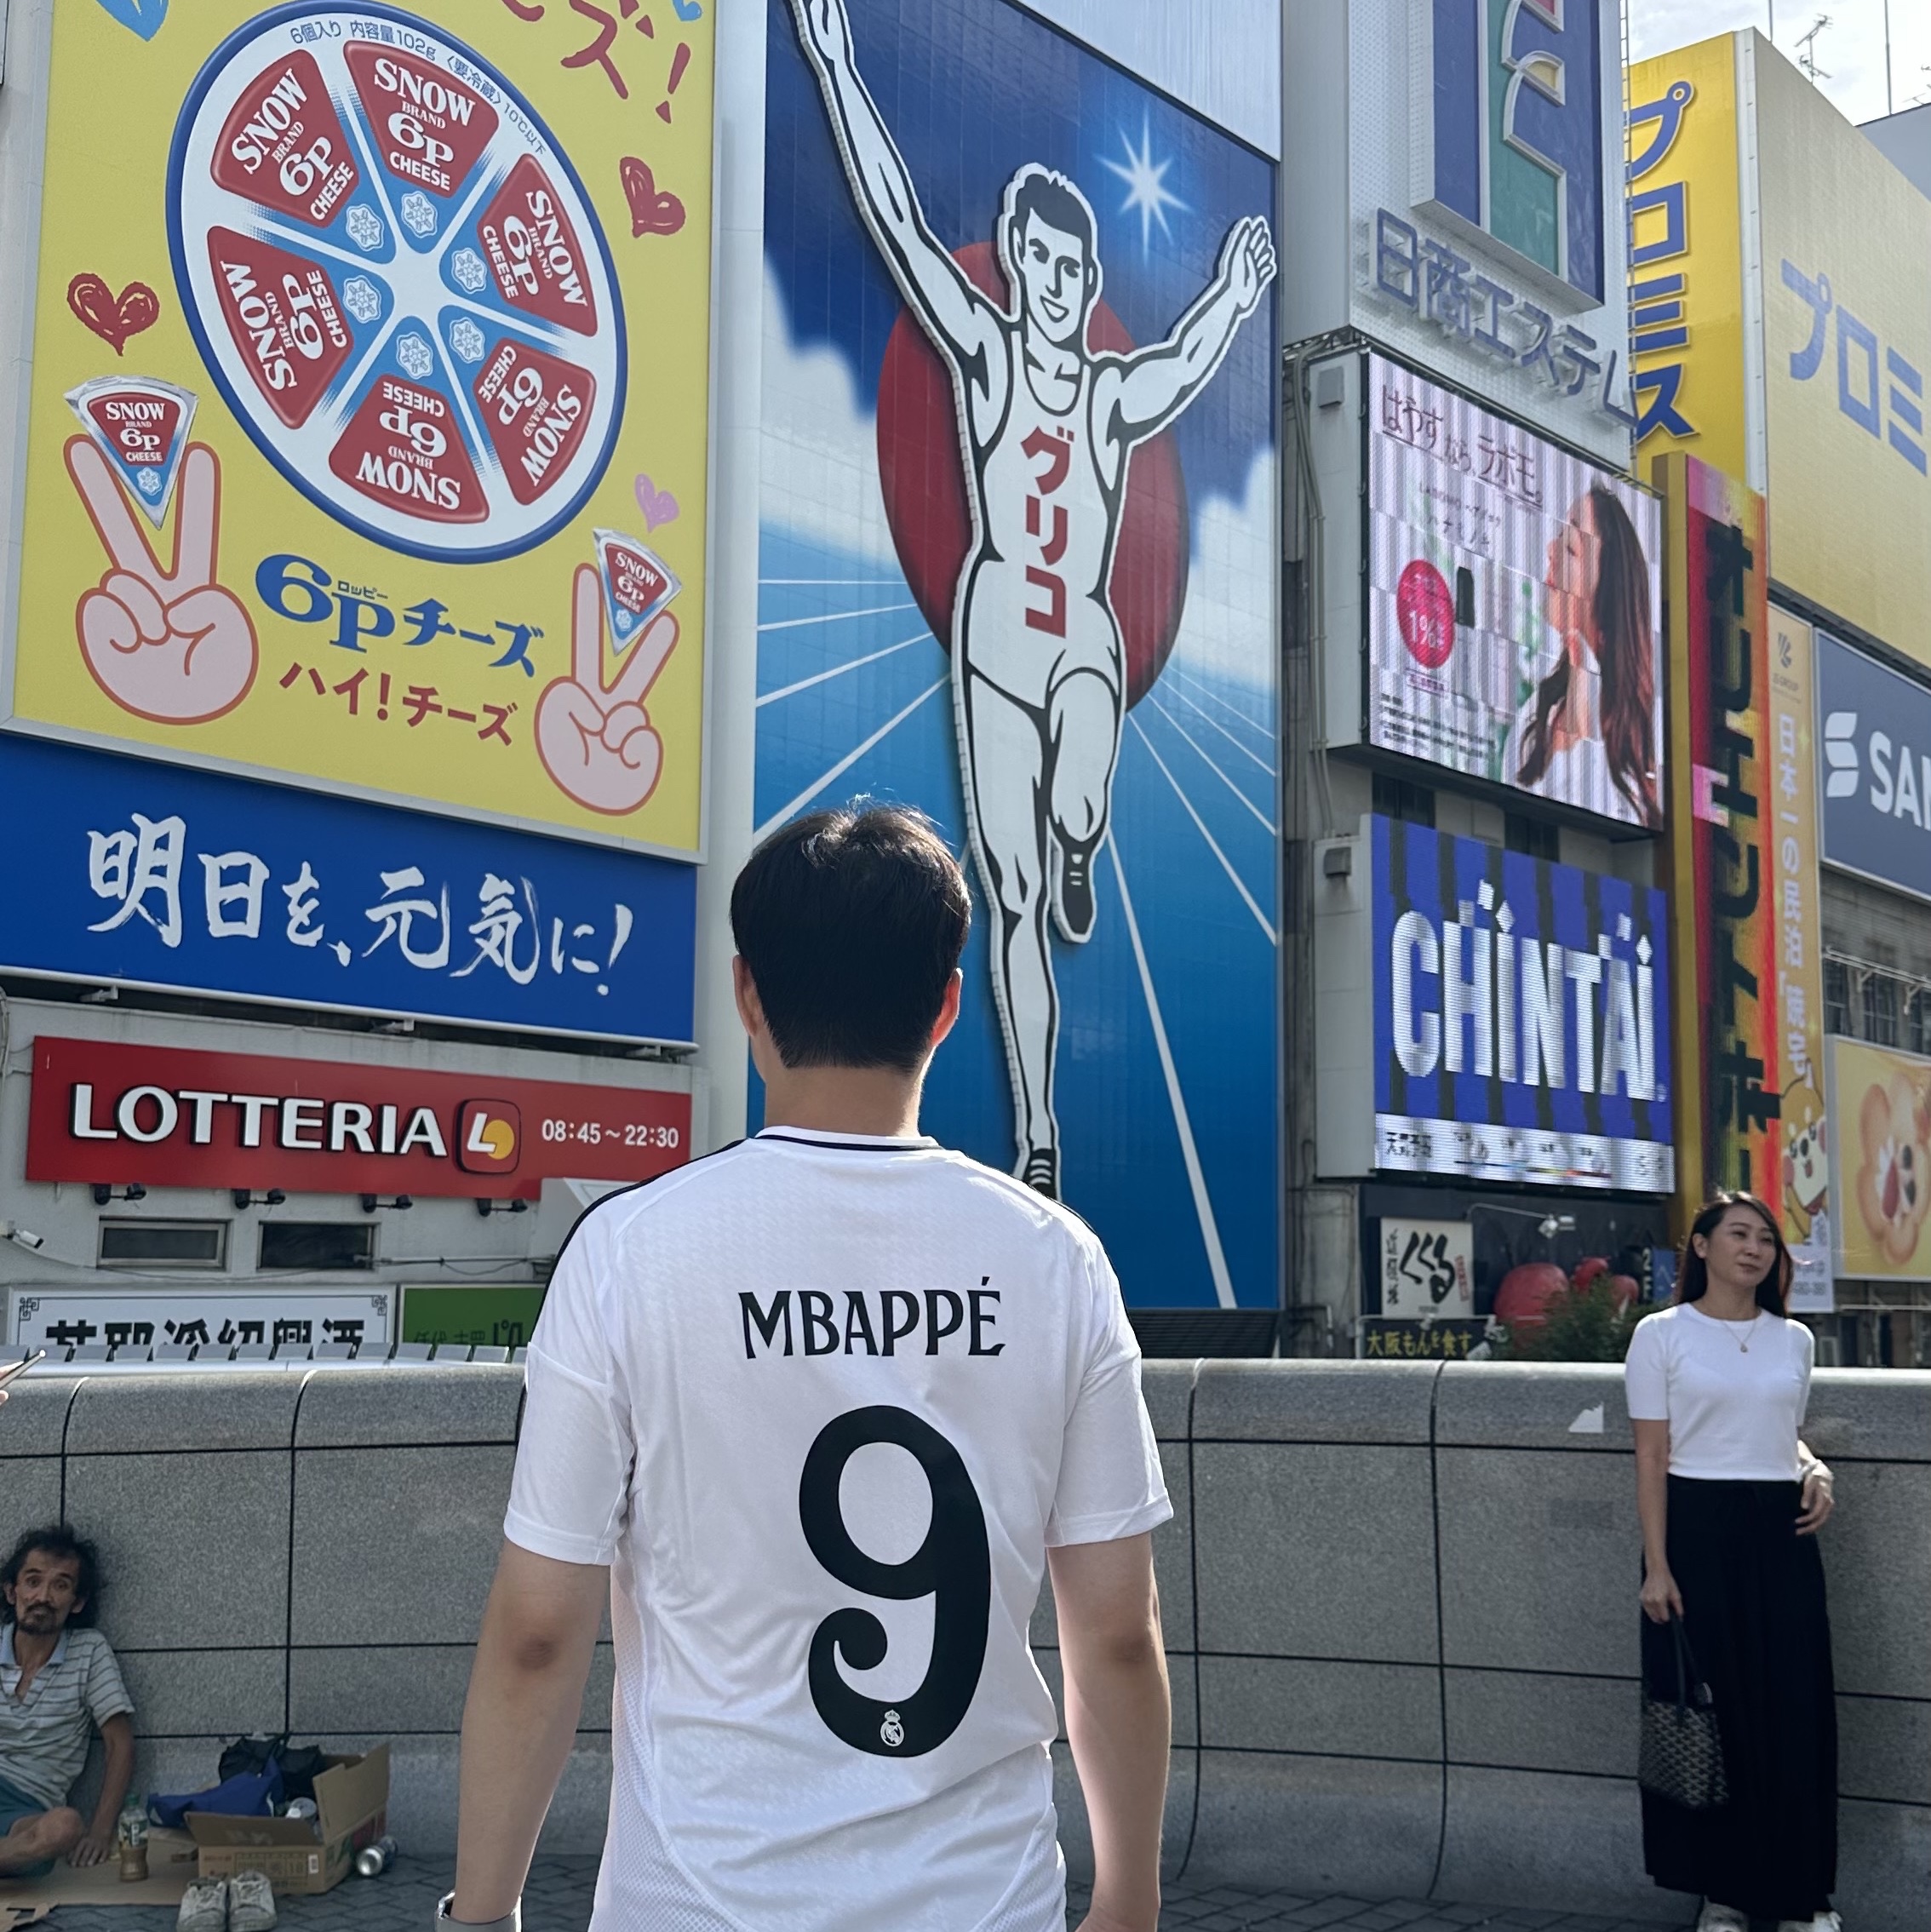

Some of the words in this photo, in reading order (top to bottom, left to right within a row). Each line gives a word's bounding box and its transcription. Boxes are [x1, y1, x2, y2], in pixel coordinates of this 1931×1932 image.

[290, 20, 341, 43] 6個入り
[349, 20, 436, 61] 内容量102g
[232, 68, 308, 175] SNOW
[375, 58, 476, 127] SNOW
[402, 101, 447, 129] BRAND
[272, 122, 305, 163] BRAND
[389, 152, 451, 191] CHEESE
[310, 162, 355, 221] CHEESE
[483, 225, 519, 299] CHEESE
[525, 190, 588, 307] SNOW
[528, 227, 553, 279] BRAND
[1622, 81, 1699, 446] プロミス
[220, 261, 298, 391] SNOW
[265, 291, 295, 349] BRAND
[307, 269, 348, 349] CHEESE
[478, 346, 518, 404] CHEESE
[1780, 258, 1928, 478] プロミ
[105, 402, 165, 421] SNOW
[383, 381, 445, 419] CHEESE
[523, 397, 550, 438] BRAND
[126, 452, 163, 462] CHEESE
[387, 445, 434, 470] BRAND
[520, 384, 582, 487] SNOW
[355, 451, 461, 511] SNOW
[1019, 425, 1074, 639] グリコ
[337, 580, 388, 599] ロッピー
[616, 552, 659, 587] SNOW
[278, 662, 519, 747] ハイ!チーズ
[87, 812, 634, 996] 明日を、元気に!
[71, 1082, 448, 1158] LOTTERIA
[738, 1276, 1006, 1359] MBAPPÉ
[798, 1404, 991, 1757] 9
